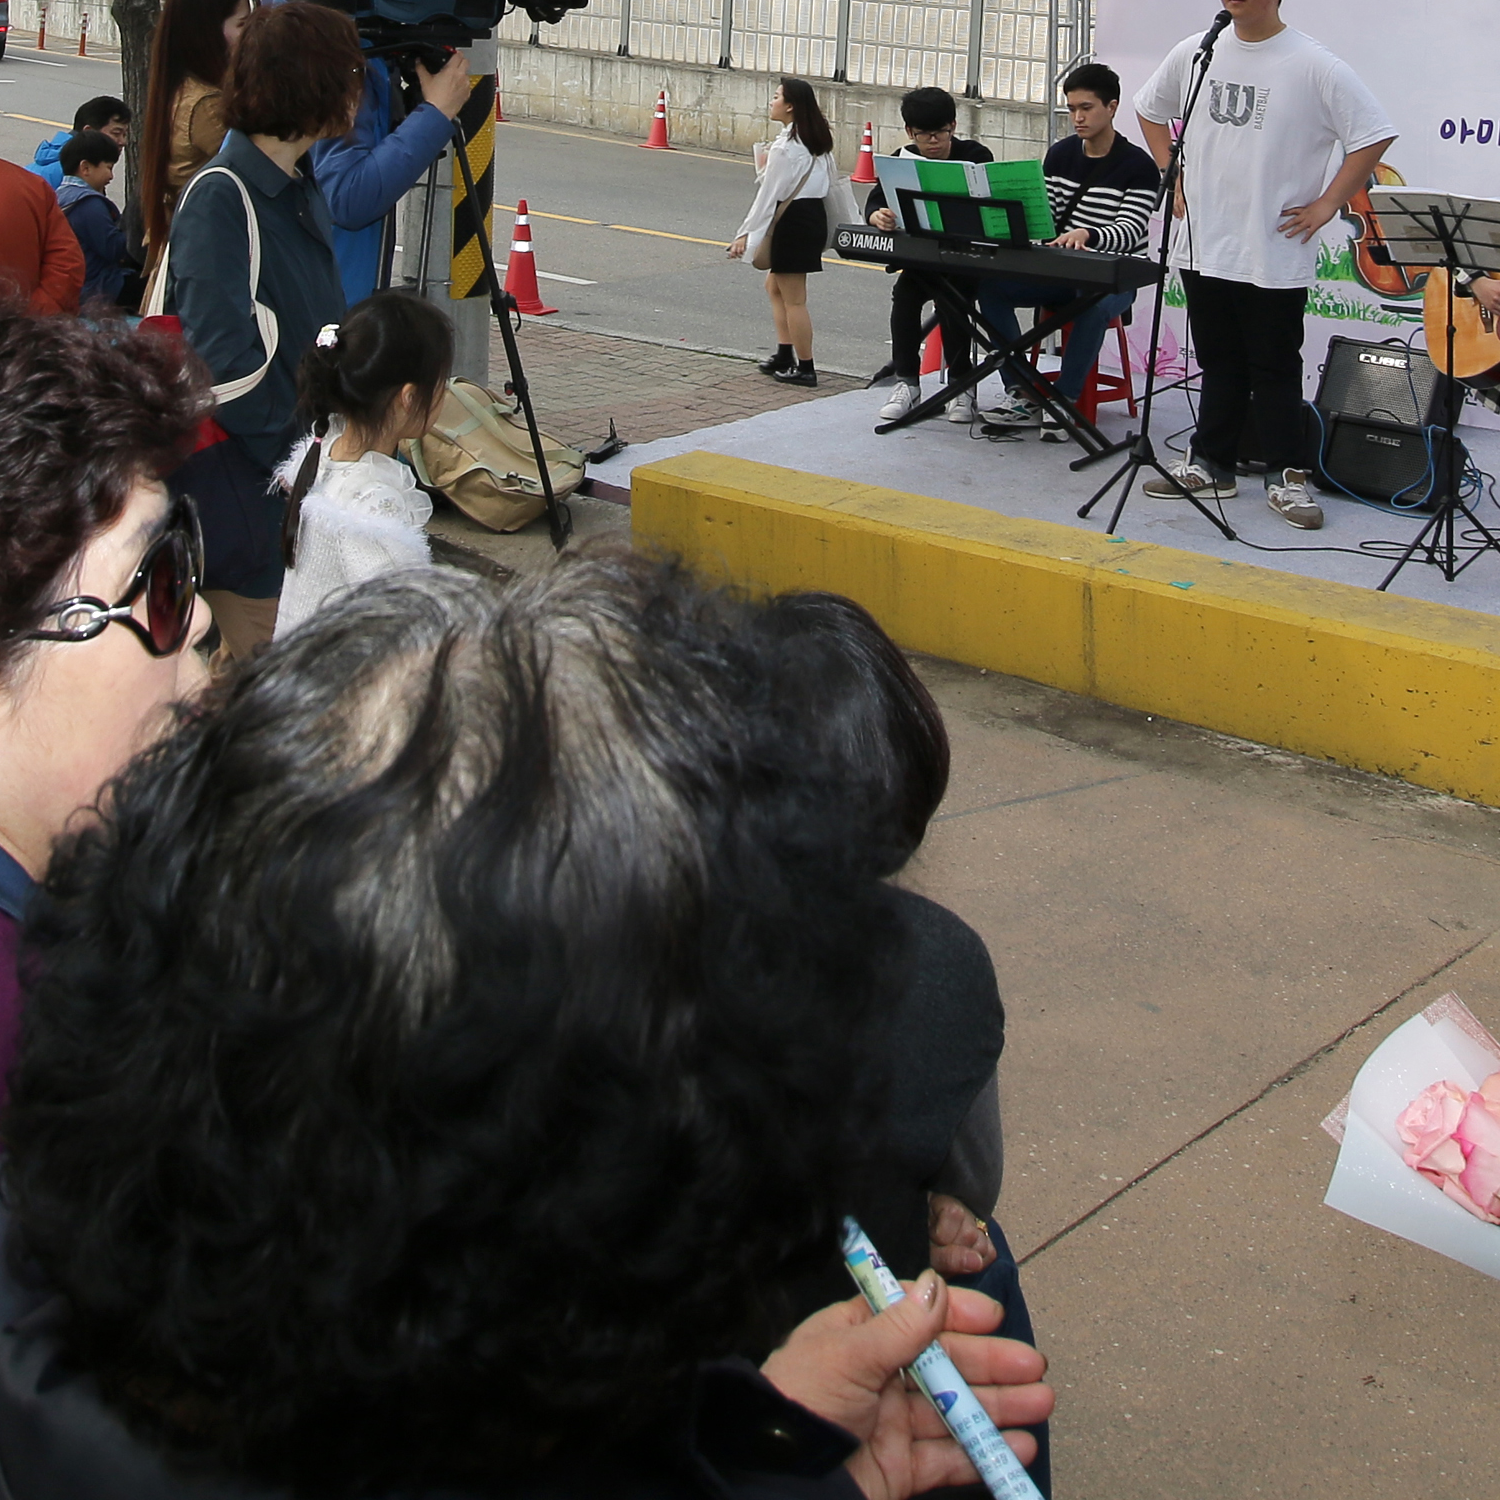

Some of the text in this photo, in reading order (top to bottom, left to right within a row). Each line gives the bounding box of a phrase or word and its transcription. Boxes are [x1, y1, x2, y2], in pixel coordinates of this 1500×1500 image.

[1254, 87, 1271, 131] BASKETBALL
[852, 233, 894, 252] YAMAHA
[1359, 353, 1408, 369] CUBE
[1366, 434, 1401, 447] CUBE
